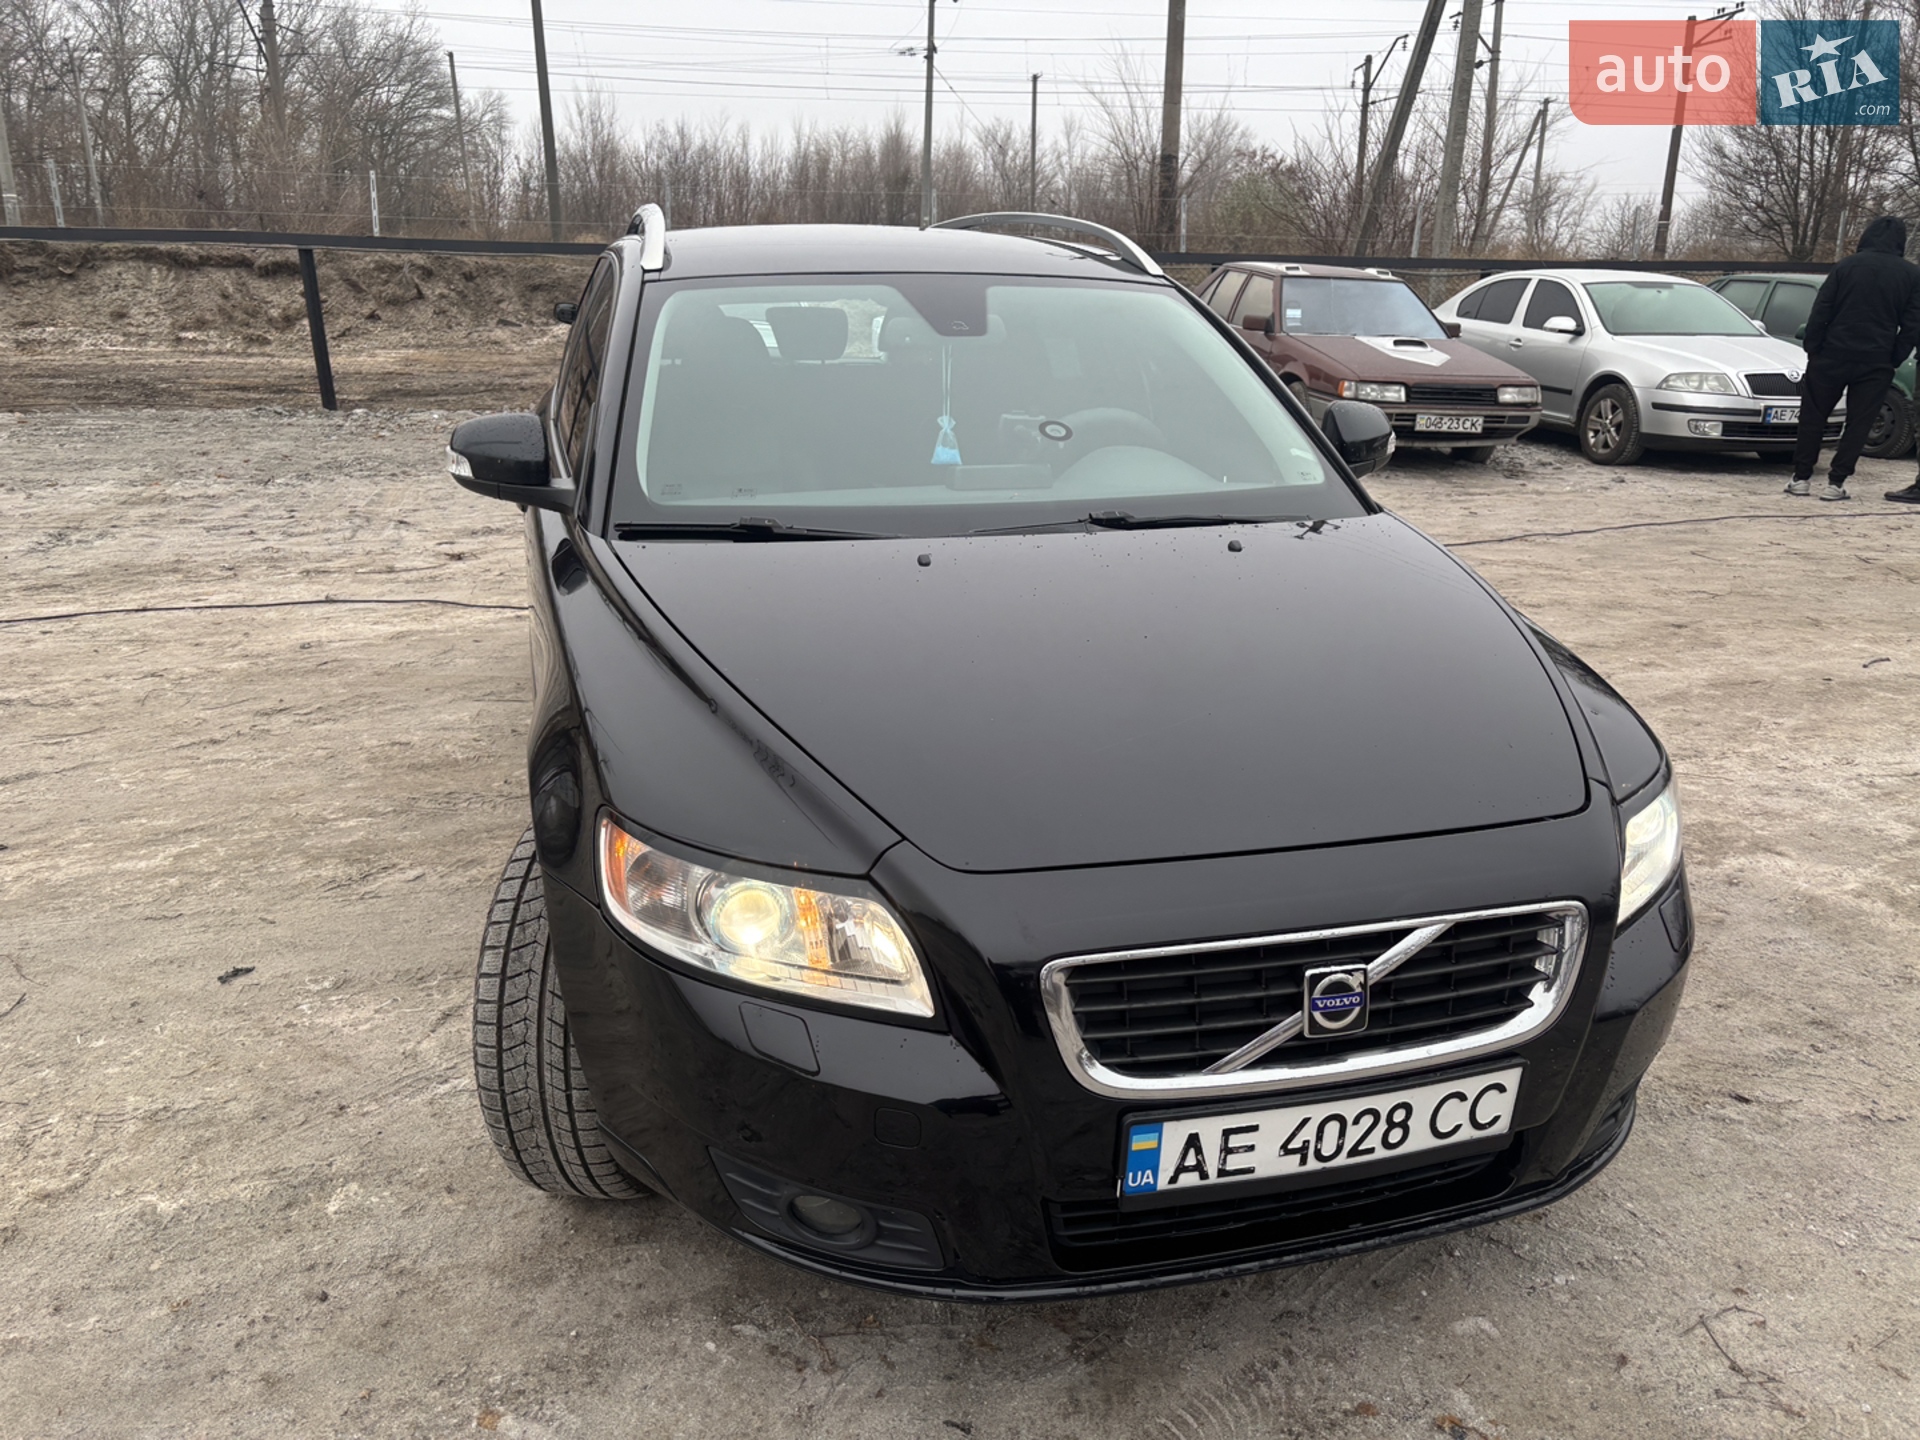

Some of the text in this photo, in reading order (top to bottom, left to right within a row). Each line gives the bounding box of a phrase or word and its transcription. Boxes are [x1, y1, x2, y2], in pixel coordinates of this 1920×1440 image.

[1771, 409, 1788, 421] AE
[1315, 995, 1361, 1008] VOLVO
[1167, 1081, 1508, 1185] AE 4028 CC
[1127, 1169, 1155, 1187] UA
